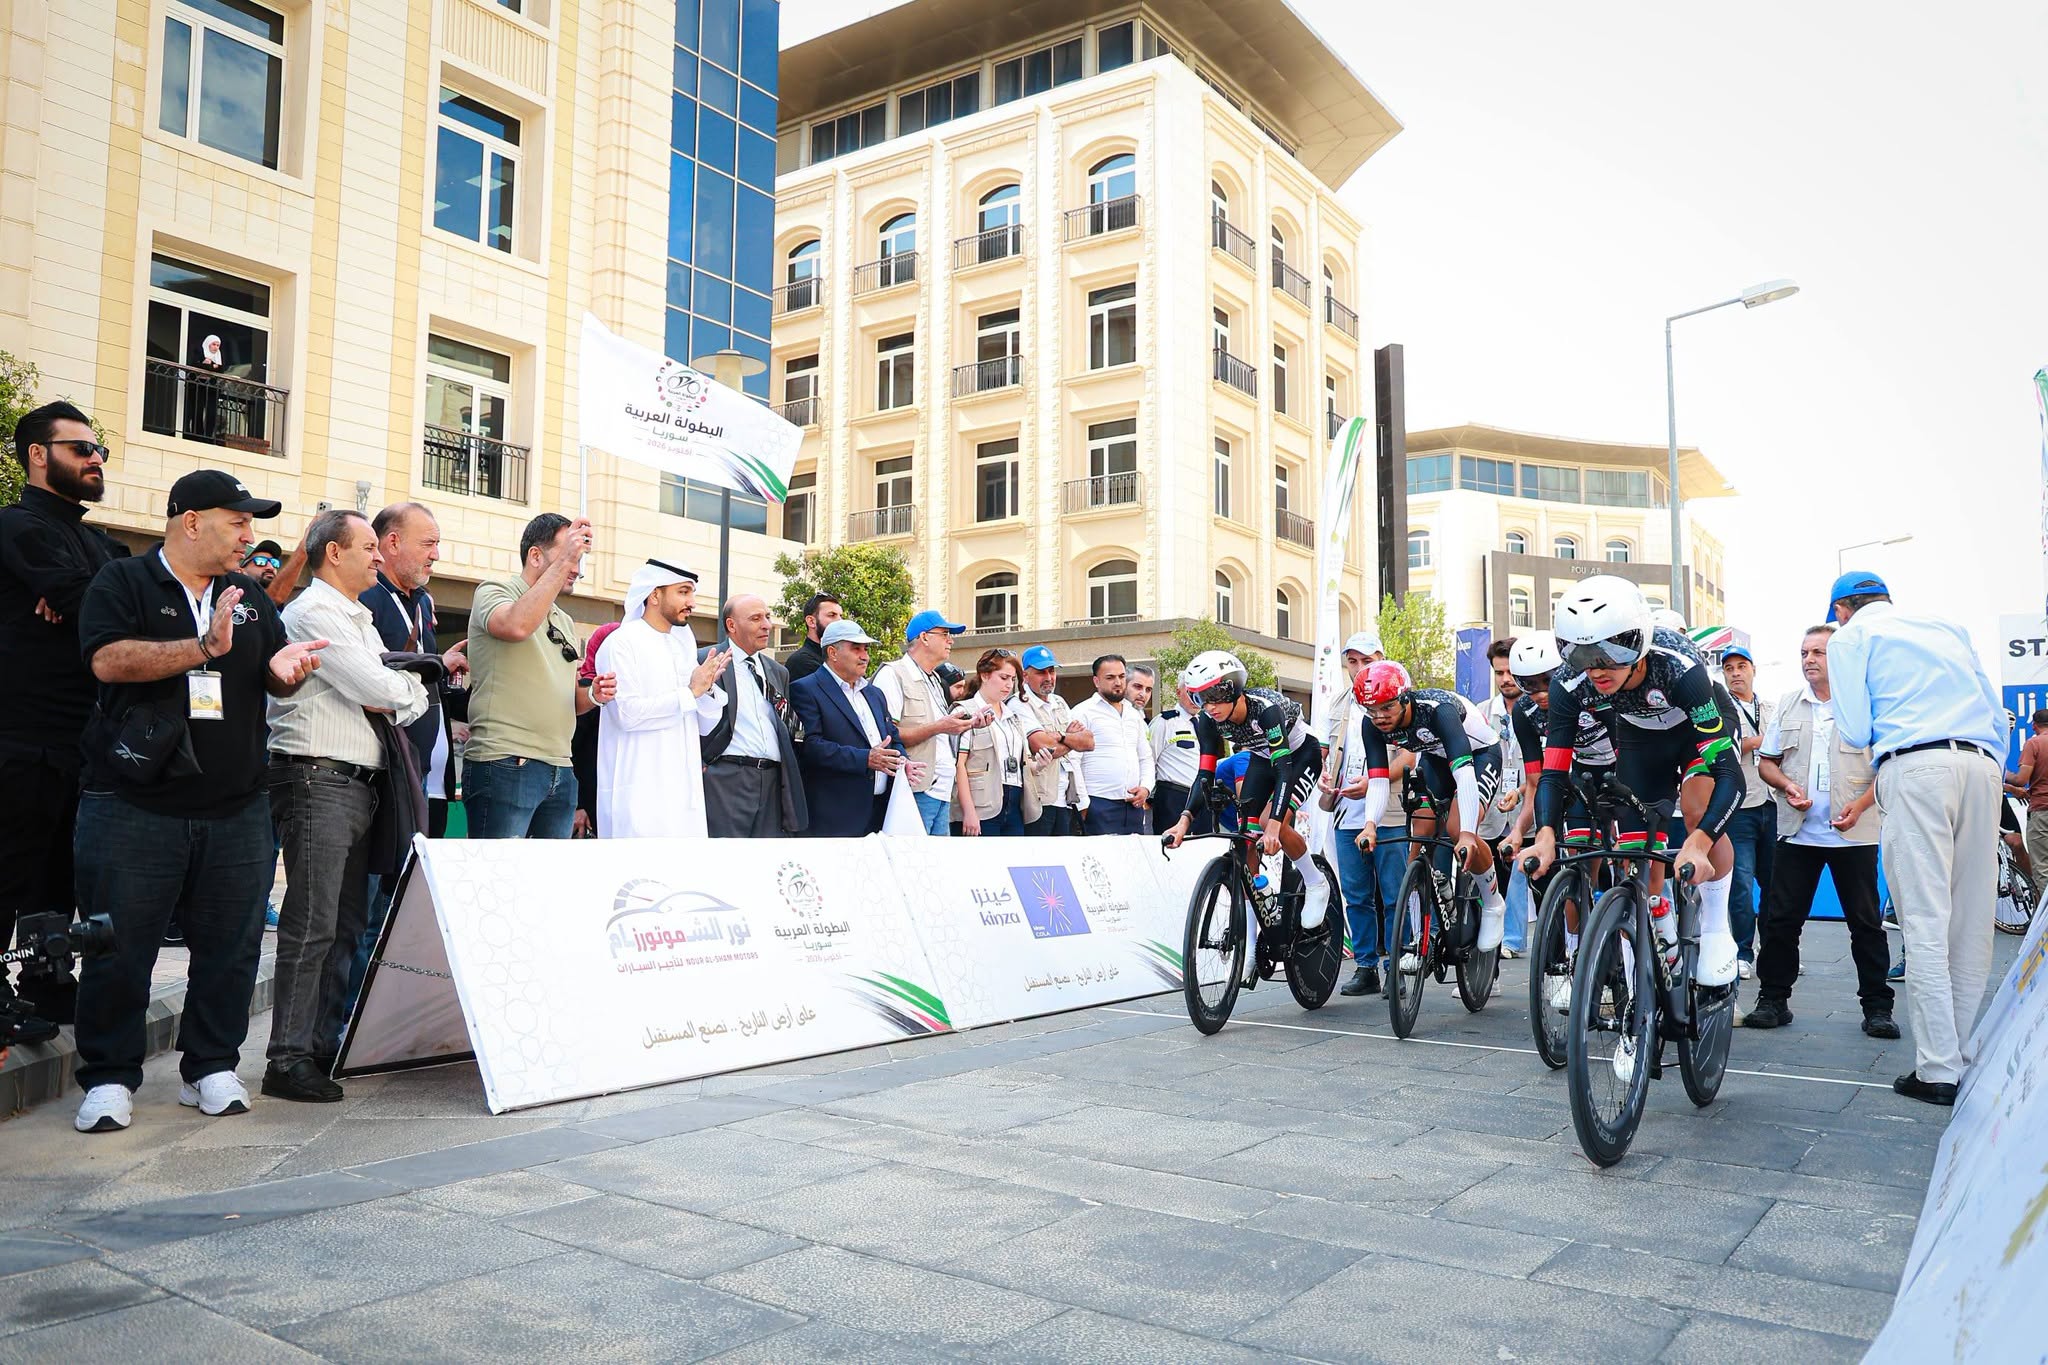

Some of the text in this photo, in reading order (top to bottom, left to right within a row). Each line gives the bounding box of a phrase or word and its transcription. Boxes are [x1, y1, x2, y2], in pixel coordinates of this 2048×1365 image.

[625, 403, 723, 438] البطولة العربية
[647, 438, 667, 450] 2026
[652, 426, 689, 442] سوريا
[2009, 638, 2048, 658] ST
[1219, 659, 1242, 670] ME
[1294, 766, 1316, 801] UAE
[1478, 762, 1500, 804] UAE
[971, 887, 1012, 907] كينزا
[979, 909, 1021, 926] kinza
[727, 916, 752, 945] نور
[774, 921, 851, 941] البطولة العربية
[803, 940, 833, 951] سوريا
[616, 961, 657, 975] السيارات
[738, 1010, 769, 1037] التاريخ
[771, 1003, 794, 1030] أرض
[796, 1004, 817, 1026] على
[642, 1020, 697, 1049] المستقبل
[698, 1020, 728, 1043] نصنع
